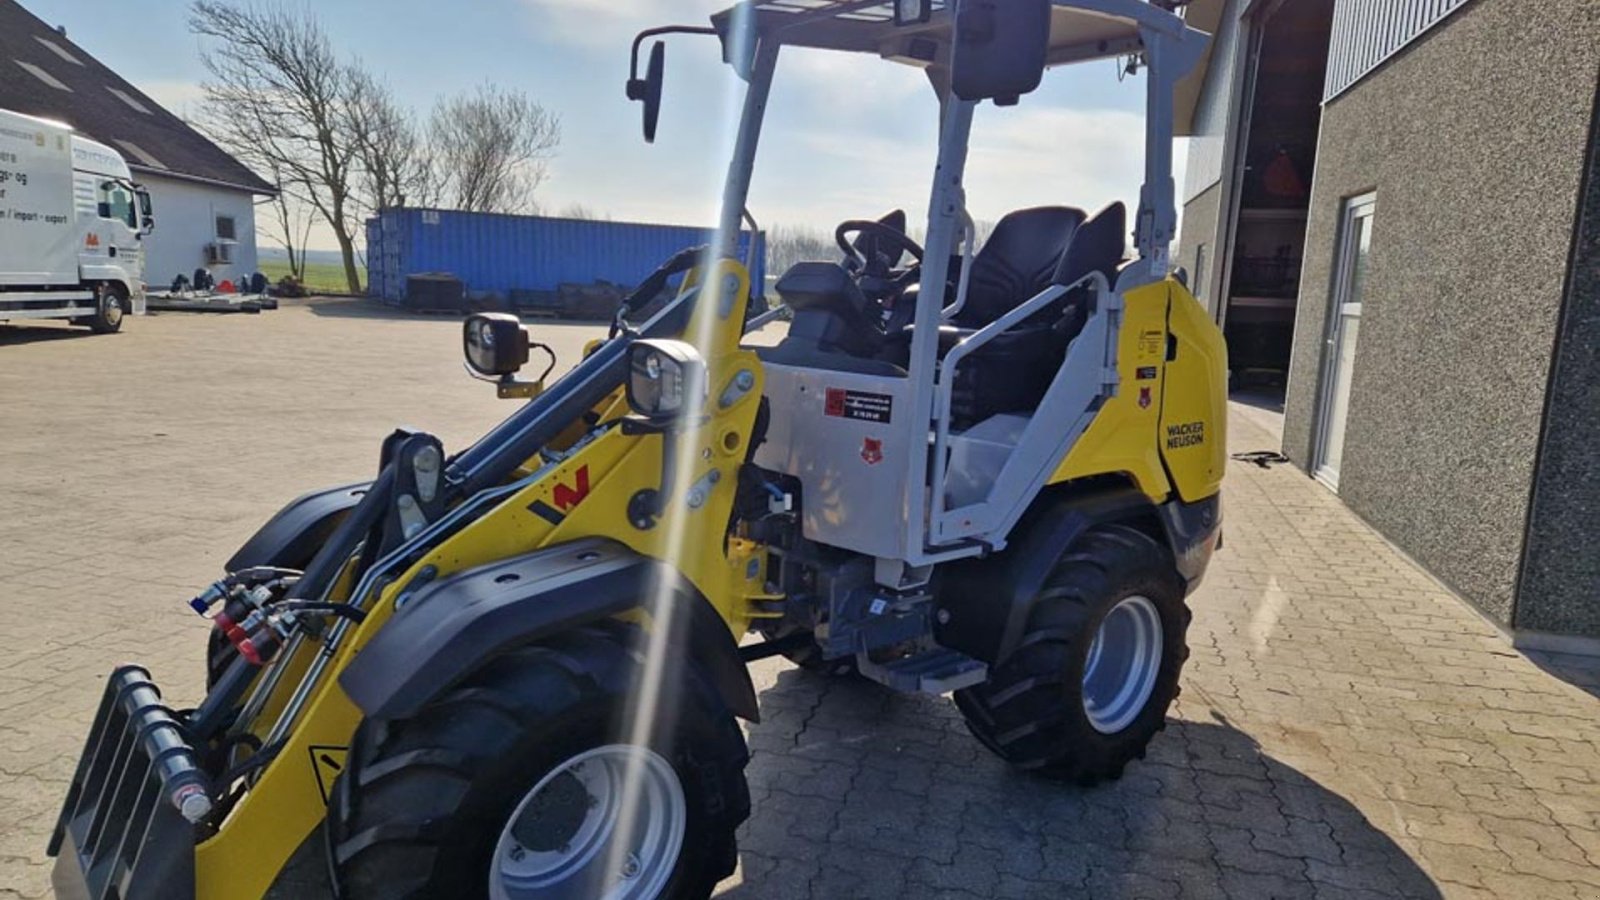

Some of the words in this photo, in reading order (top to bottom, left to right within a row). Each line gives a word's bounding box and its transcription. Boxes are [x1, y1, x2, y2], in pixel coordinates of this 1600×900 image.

[16, 173, 27, 185] og
[14, 210, 38, 221] import
[45, 214, 67, 224] export
[1167, 421, 1204, 436] WACKER
[1167, 434, 1204, 449] NEUSON
